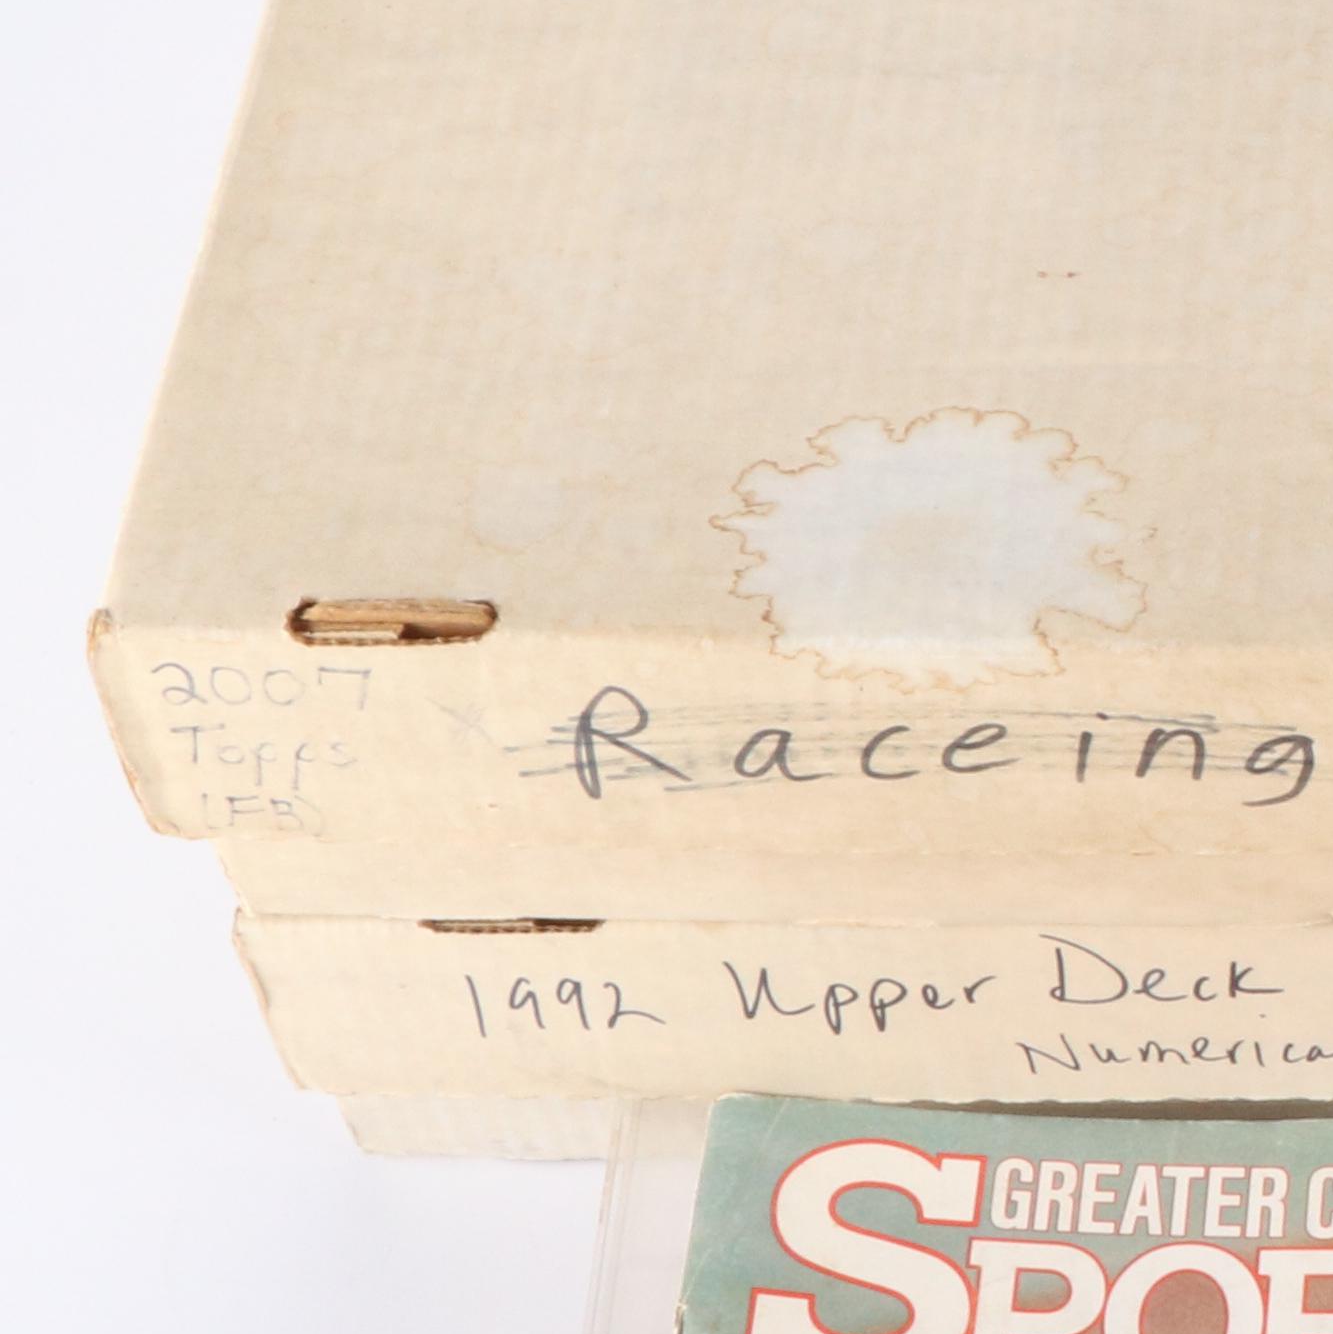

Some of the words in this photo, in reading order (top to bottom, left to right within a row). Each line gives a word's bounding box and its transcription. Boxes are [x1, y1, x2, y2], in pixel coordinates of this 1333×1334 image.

[151, 662, 372, 709] 2007
[573, 685, 1316, 806] Raceing
[464, 975, 666, 1037] 1992
[723, 960, 996, 1036] Upper
[1039, 934, 1283, 1005] Deck
[989, 1156, 1286, 1239] GREATER
